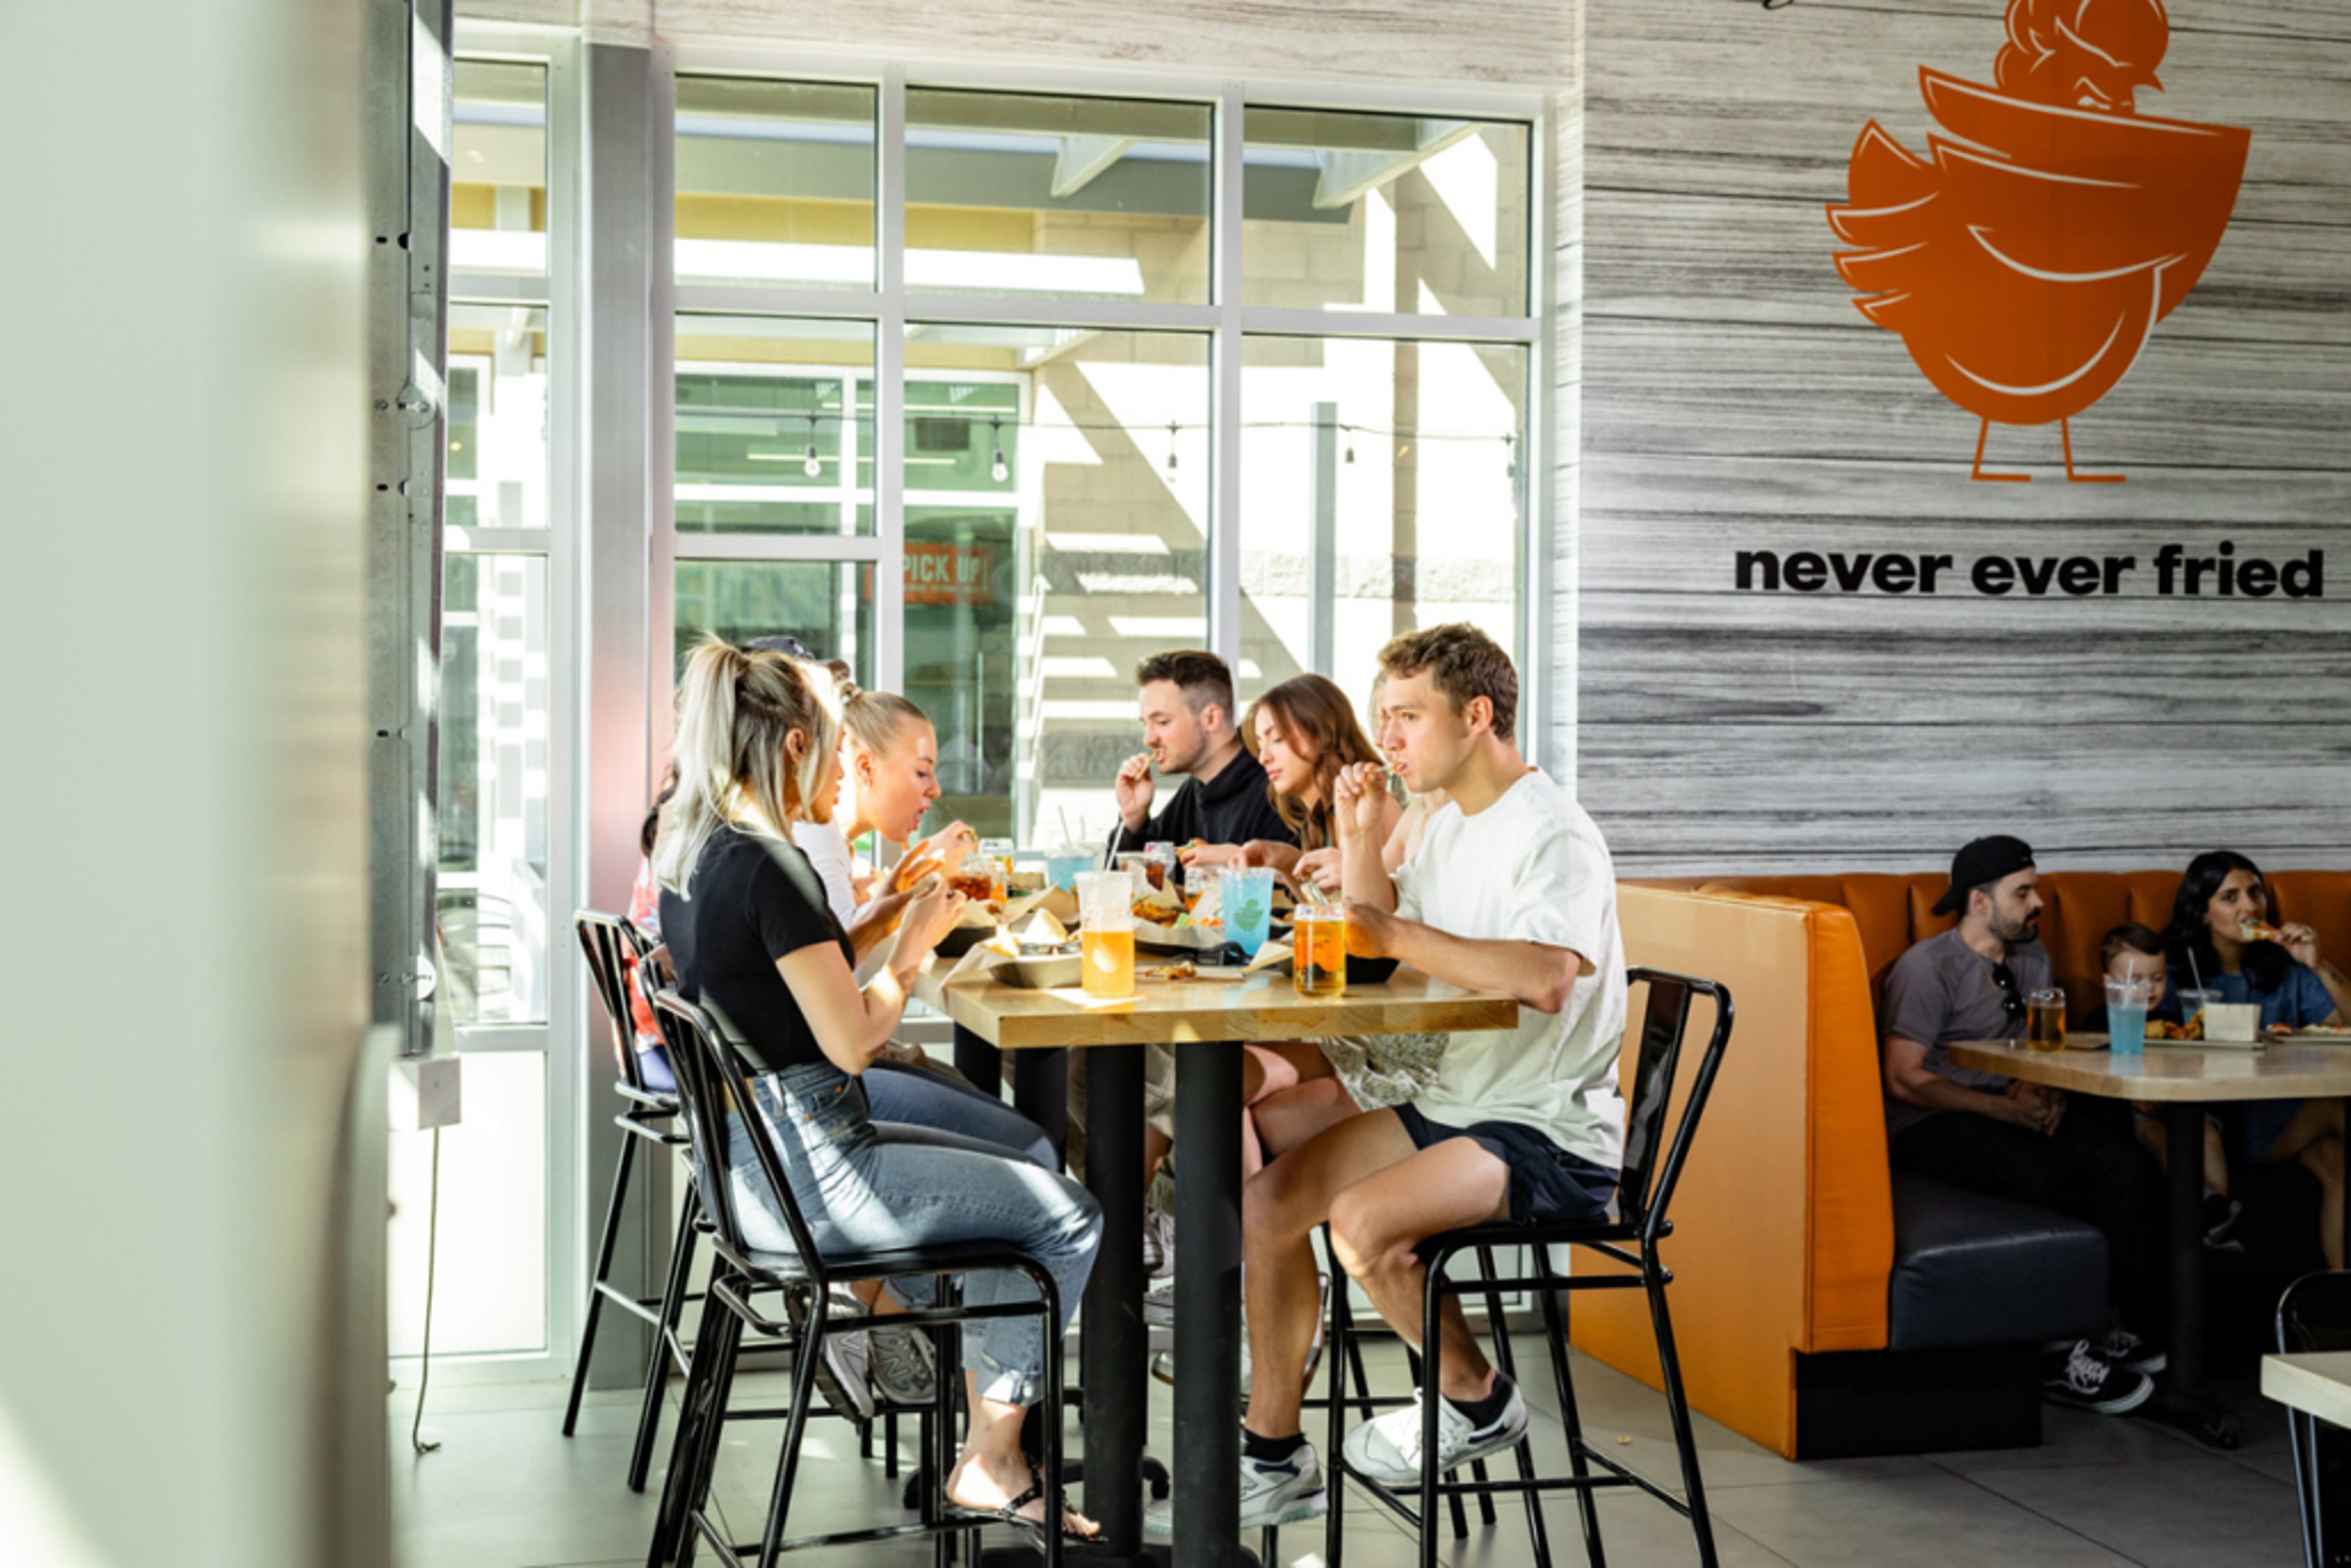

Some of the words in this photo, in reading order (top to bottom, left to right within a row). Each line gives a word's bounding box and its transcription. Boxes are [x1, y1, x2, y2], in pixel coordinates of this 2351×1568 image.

[903, 553, 950, 583] PICK
[1736, 551, 1953, 595] never
[1971, 555, 2137, 596] ever
[2153, 539, 2325, 600] fried
